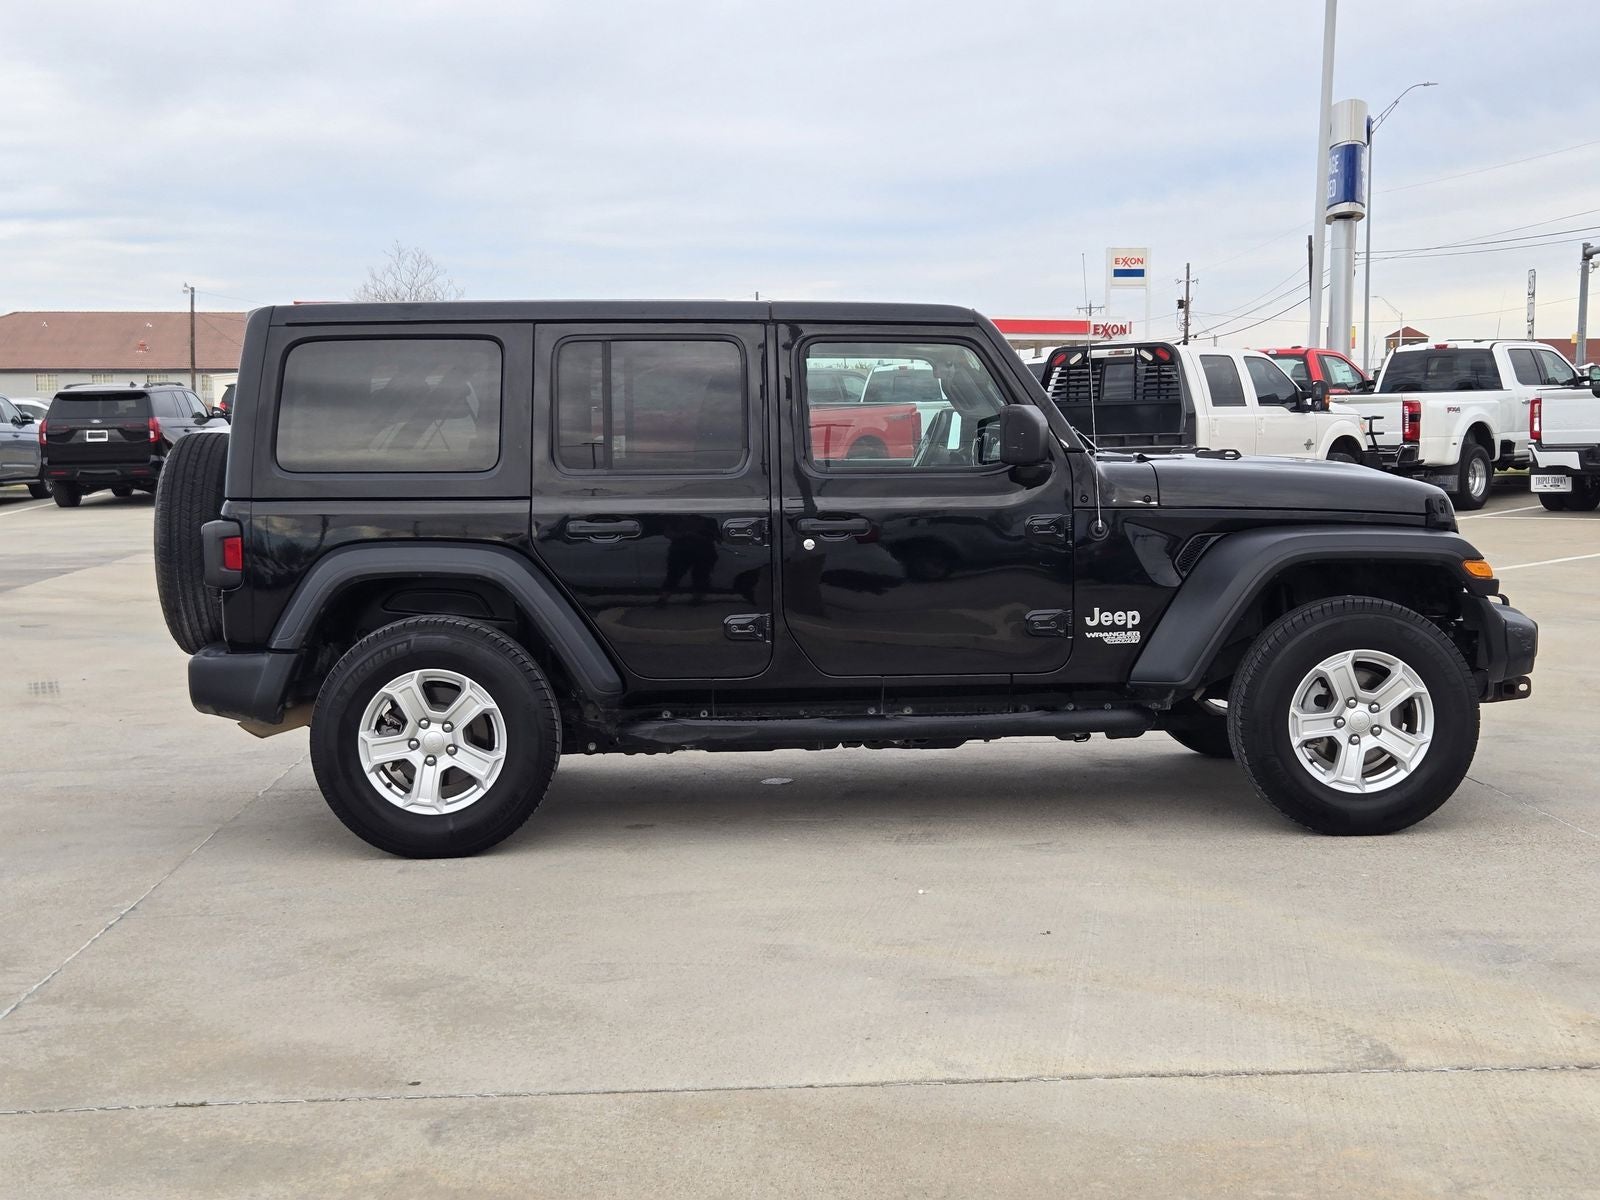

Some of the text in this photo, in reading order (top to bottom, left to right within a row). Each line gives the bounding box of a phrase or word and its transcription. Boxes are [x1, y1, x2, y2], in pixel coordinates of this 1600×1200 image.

[1114, 256, 1144, 268] EXXON
[1092, 322, 1127, 339] EXXON
[1085, 608, 1140, 628] Jeep
